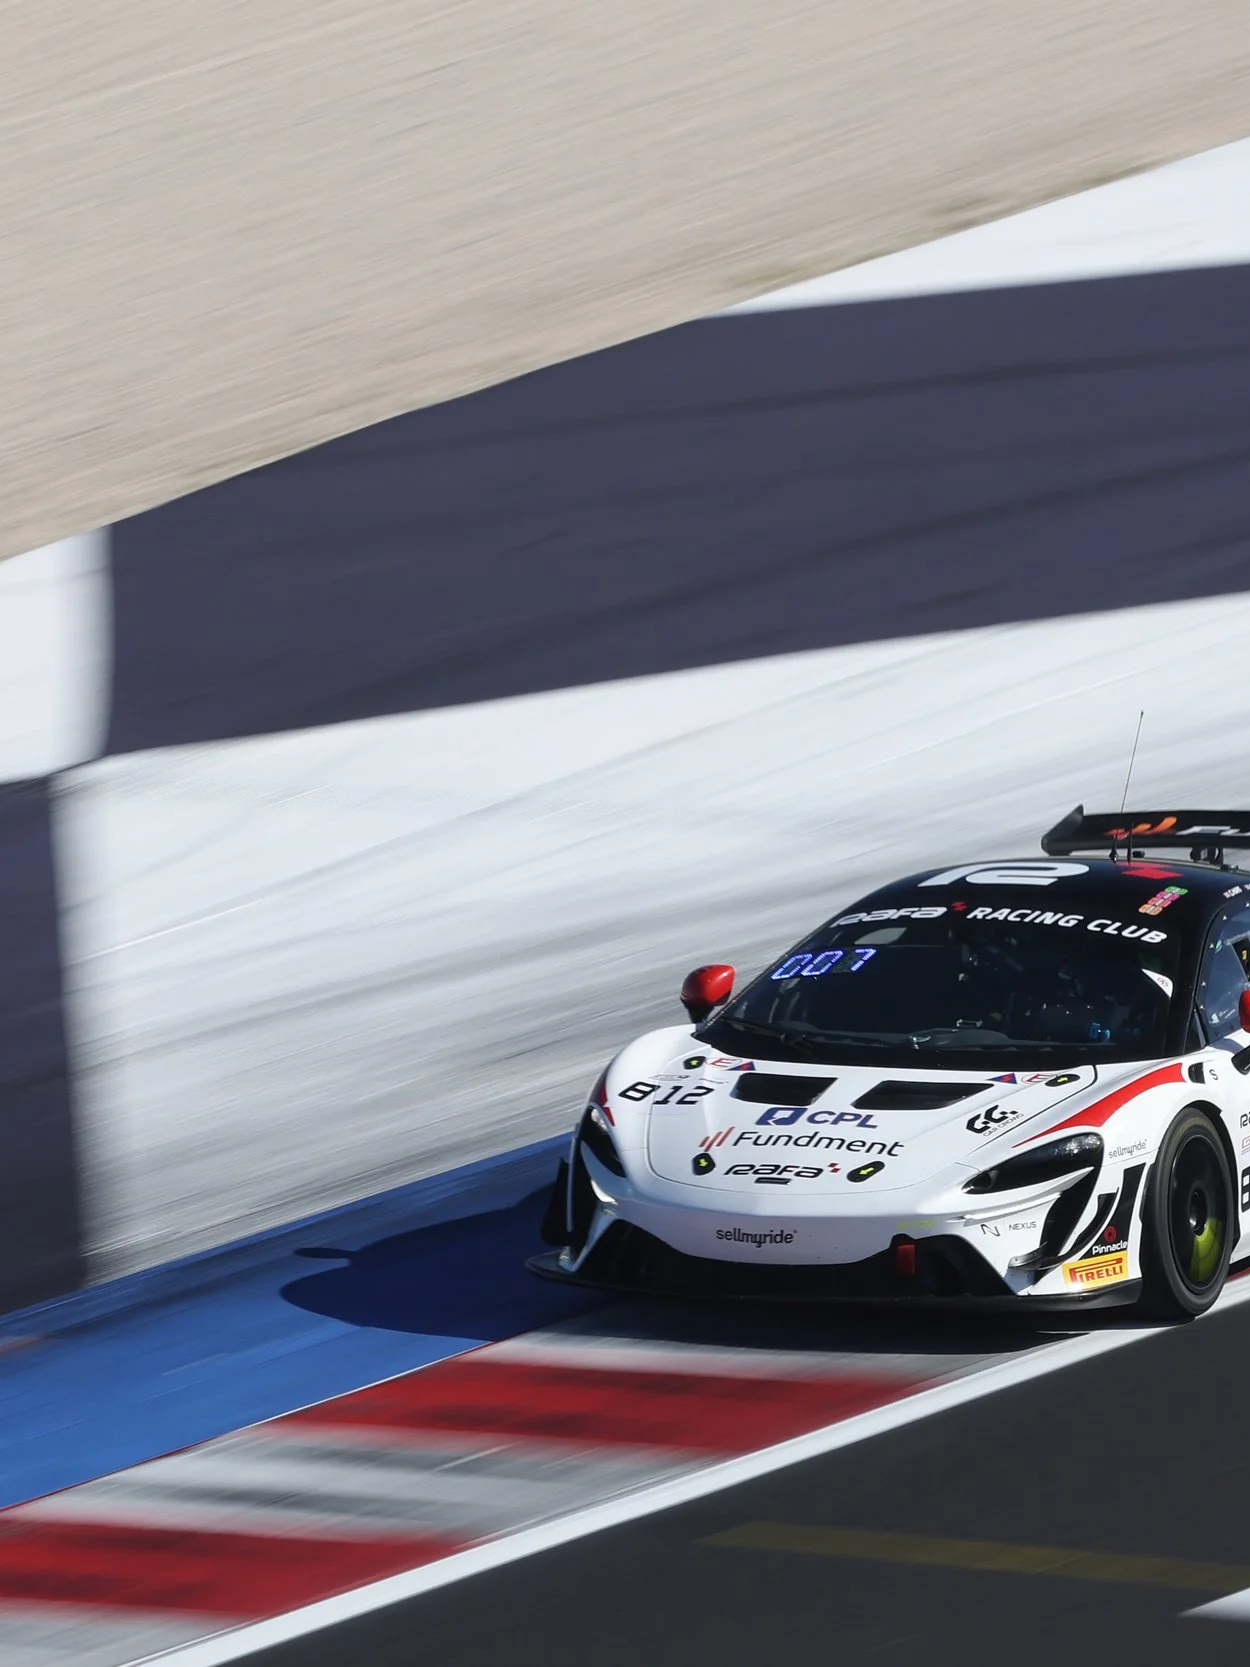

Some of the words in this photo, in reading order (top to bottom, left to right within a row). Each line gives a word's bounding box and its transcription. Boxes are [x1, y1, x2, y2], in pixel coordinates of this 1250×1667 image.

[966, 906, 1084, 928] RACING
[1086, 919, 1168, 944] CLUB
[770, 948, 877, 980] 007
[806, 1110, 878, 1129] CPL
[732, 1131, 905, 1157] Fundment
[1108, 1140, 1147, 1159] sellmyride
[1008, 1220, 1037, 1231] NEXUS
[715, 1227, 794, 1248] sellmyride
[1092, 1239, 1128, 1256] Pinnacle
[1068, 1257, 1123, 1283] PIRELLI
